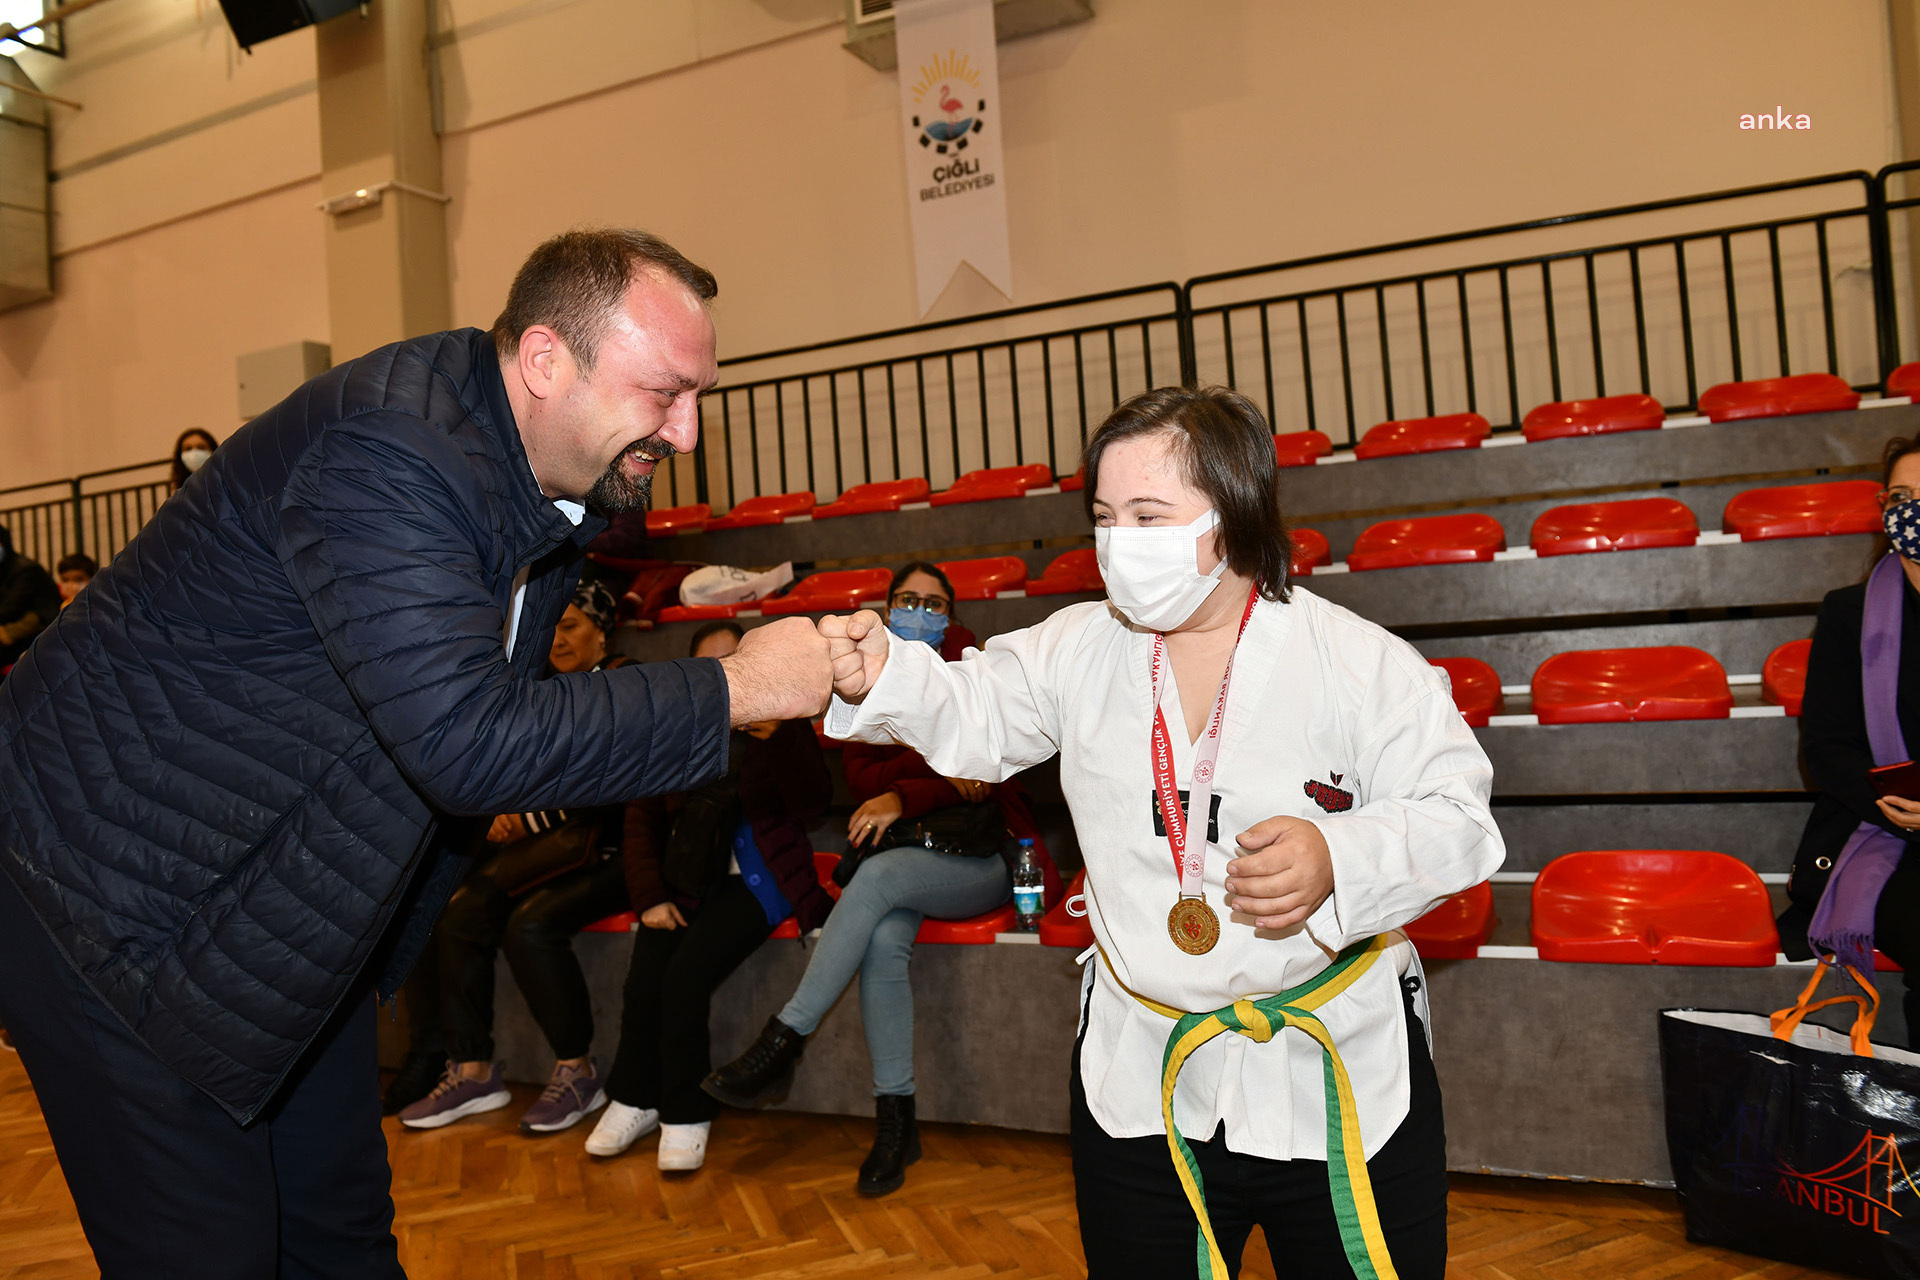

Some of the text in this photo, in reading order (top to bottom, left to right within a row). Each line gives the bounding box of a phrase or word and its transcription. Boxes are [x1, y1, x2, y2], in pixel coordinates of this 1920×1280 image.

[920, 172, 996, 202] BELEDİYESİ
[1154, 728, 1169, 770] GENÇLİK
[1159, 773, 1185, 847] CUMHURİYETİ
[1773, 1176, 1890, 1235] ANBUL
